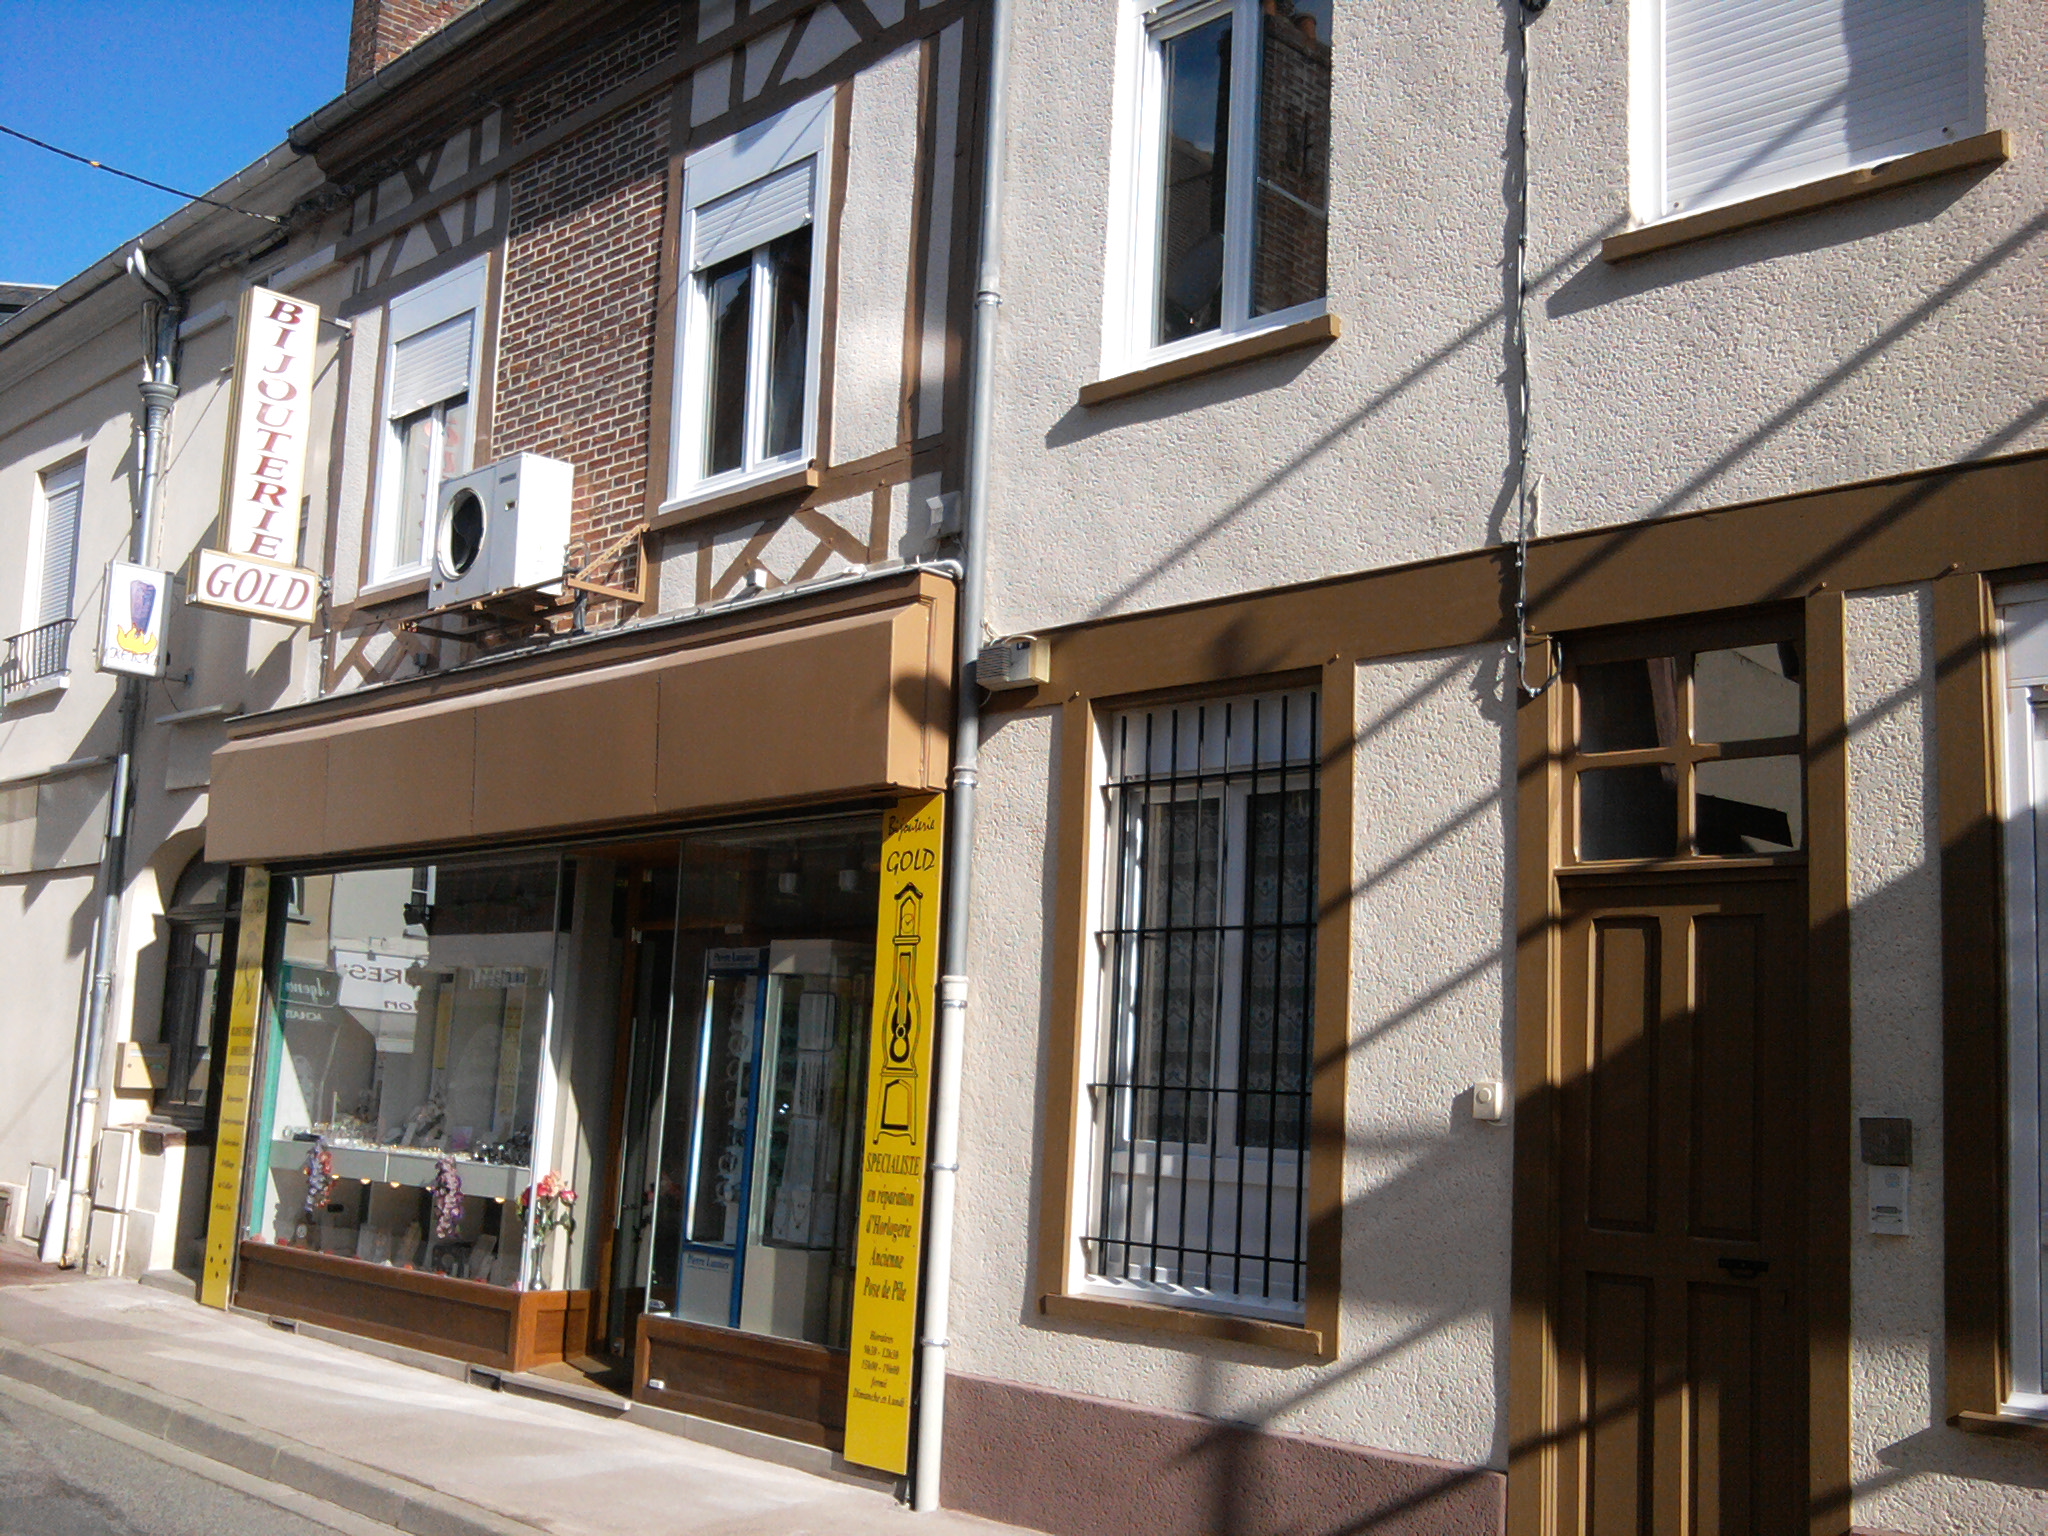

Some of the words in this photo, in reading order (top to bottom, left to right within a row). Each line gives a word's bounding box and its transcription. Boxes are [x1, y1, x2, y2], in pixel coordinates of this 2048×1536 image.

[243, 298, 304, 560] BIJOUTERIE
[205, 563, 311, 611] GOLD
[888, 815, 936, 842] Bijouterie
[886, 848, 936, 876] GOLD
[865, 1152, 921, 1176] SPECIALISTE
[865, 1214, 912, 1243] d'Horlogerie
[869, 1246, 905, 1270] Ancienne
[863, 1276, 880, 1298] Pose
[881, 1279, 891, 1299] de
